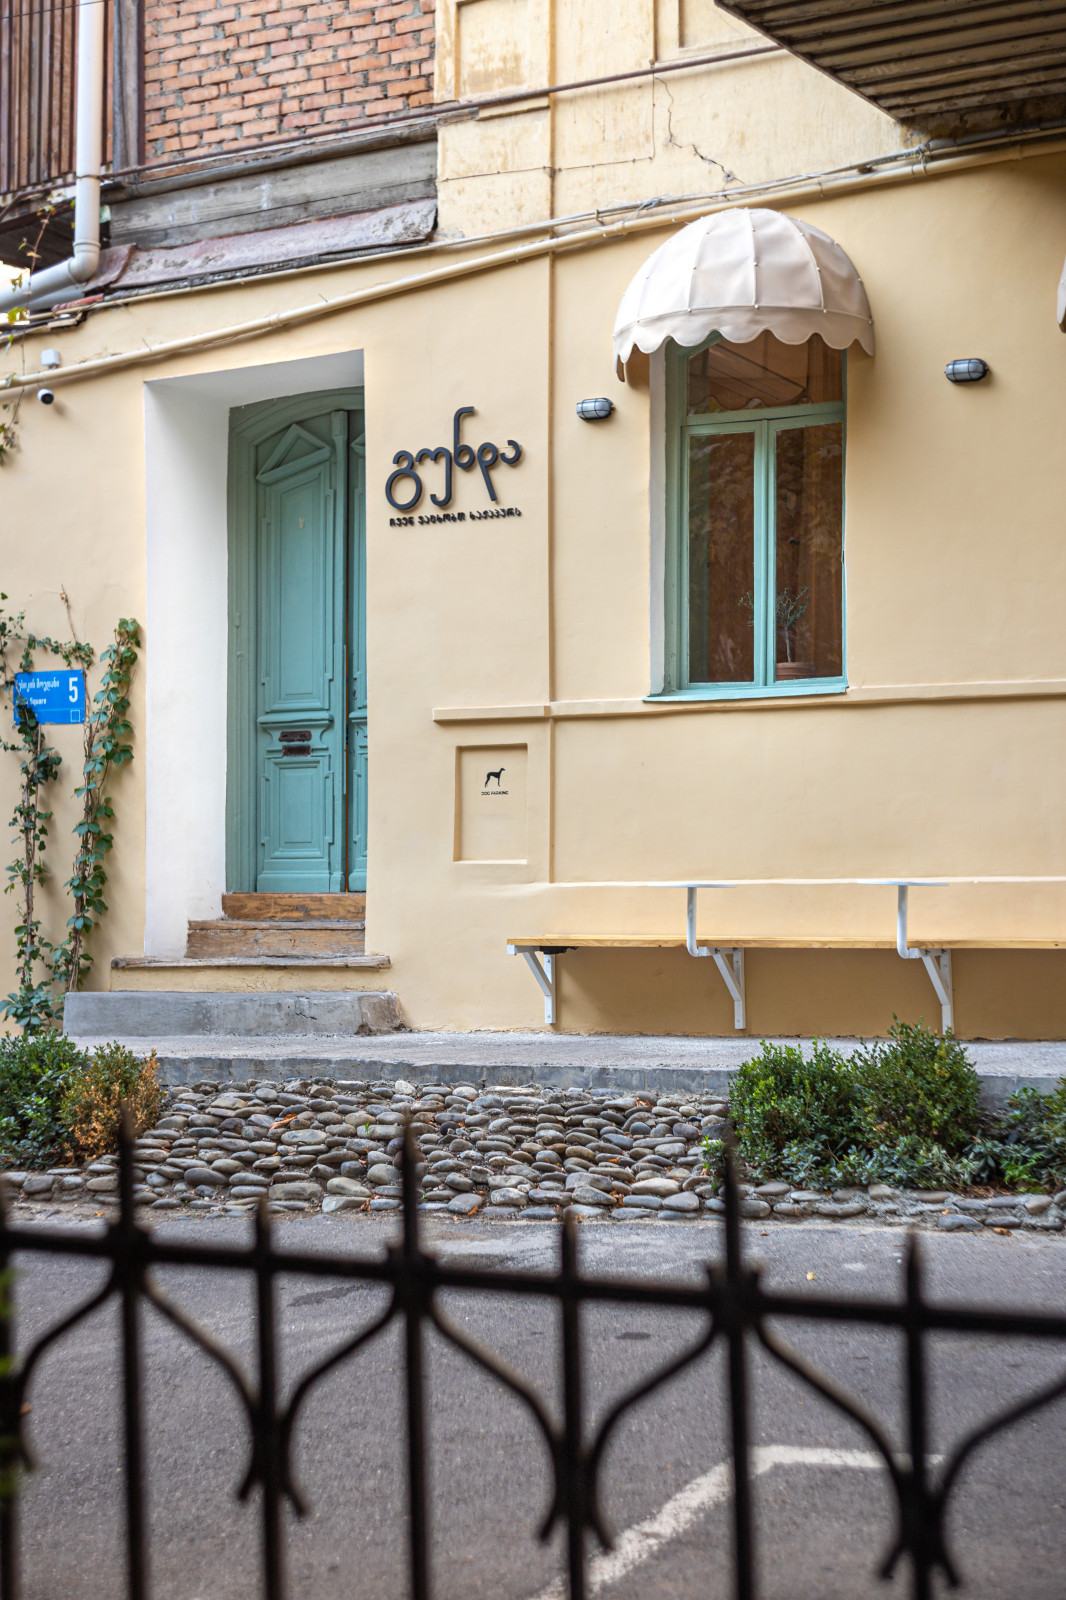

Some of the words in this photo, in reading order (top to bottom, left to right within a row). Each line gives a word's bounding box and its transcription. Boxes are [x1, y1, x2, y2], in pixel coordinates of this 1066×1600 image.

[385, 406, 522, 510] გუნდა
[29, 697, 47, 706] Square
[68, 677, 79, 703] 5
